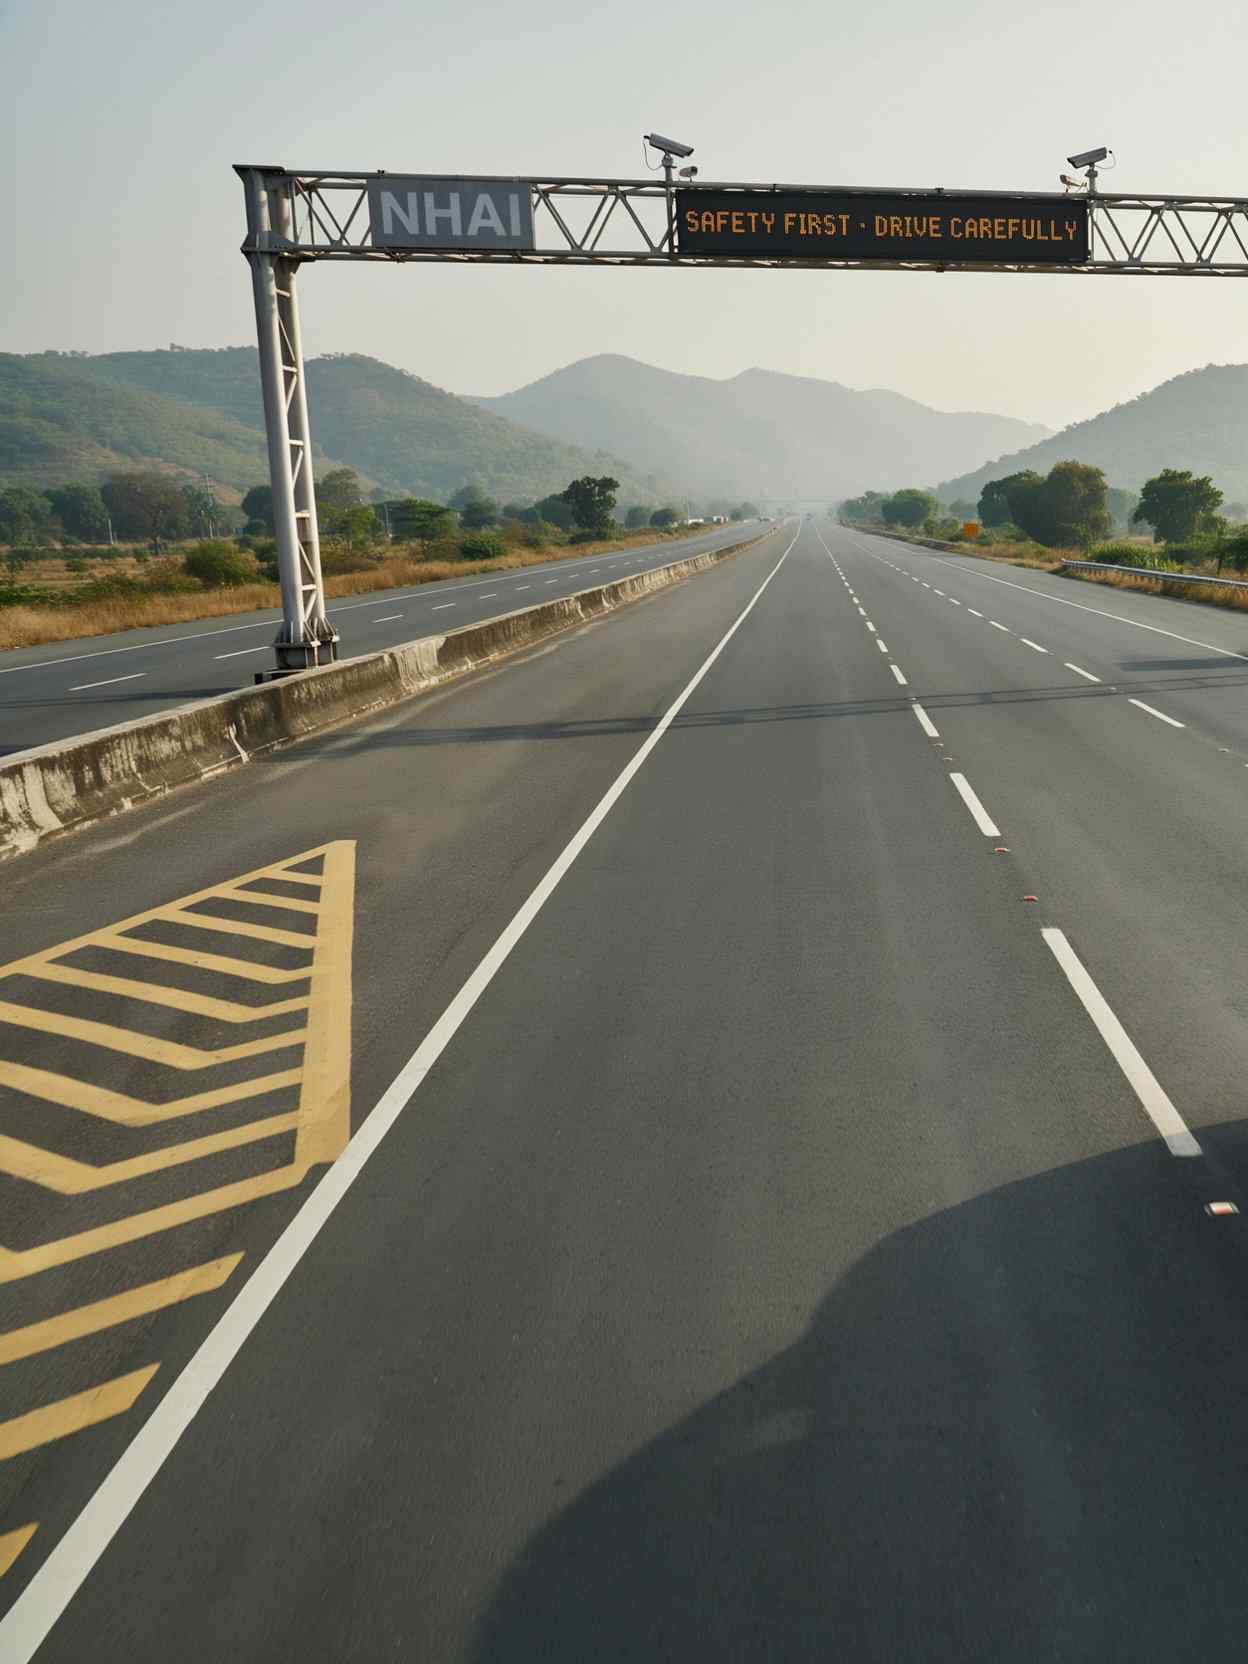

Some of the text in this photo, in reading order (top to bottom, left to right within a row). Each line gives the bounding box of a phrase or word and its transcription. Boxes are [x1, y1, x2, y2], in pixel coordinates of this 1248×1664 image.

[380, 191, 521, 236] NHAI
[685, 210, 776, 233] SAFETY
[783, 213, 850, 236] FIRST
[874, 215, 943, 238] DRIVE
[950, 217, 1078, 241] CAREFULLY
